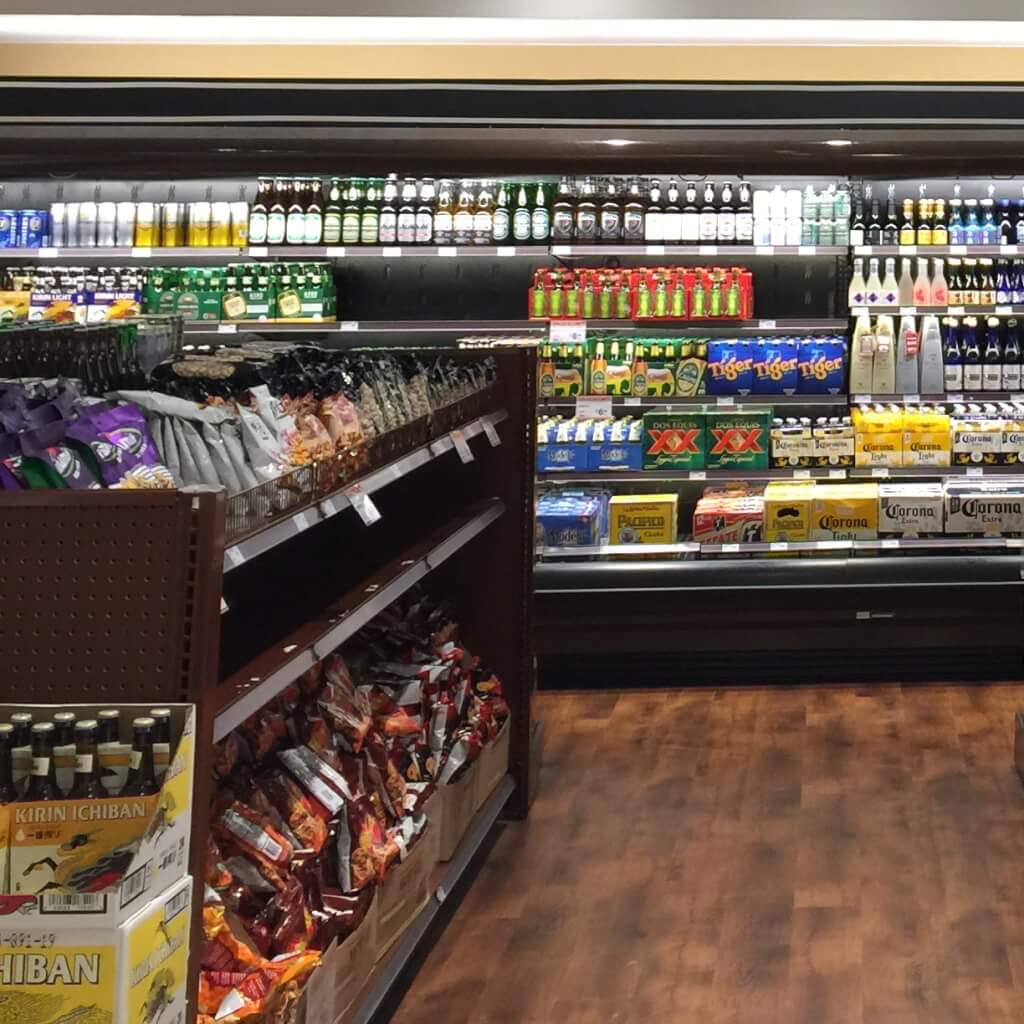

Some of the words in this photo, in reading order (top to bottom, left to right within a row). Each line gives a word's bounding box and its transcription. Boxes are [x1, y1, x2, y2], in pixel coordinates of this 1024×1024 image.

[707, 357, 753, 381] Tiger
[753, 357, 798, 381] Tiger
[798, 357, 843, 381] Tiger
[647, 429, 702, 455] XX
[710, 429, 764, 455] XX
[862, 442, 894, 452] Corona
[910, 442, 942, 452] Corona
[961, 433, 993, 444] Corona
[885, 503, 935, 519] Corona
[961, 497, 1023, 518] Corona
[819, 515, 868, 531] Corona
[15, 806, 66, 824] KIRIN
[72, 802, 146, 822] ICHIBAN
